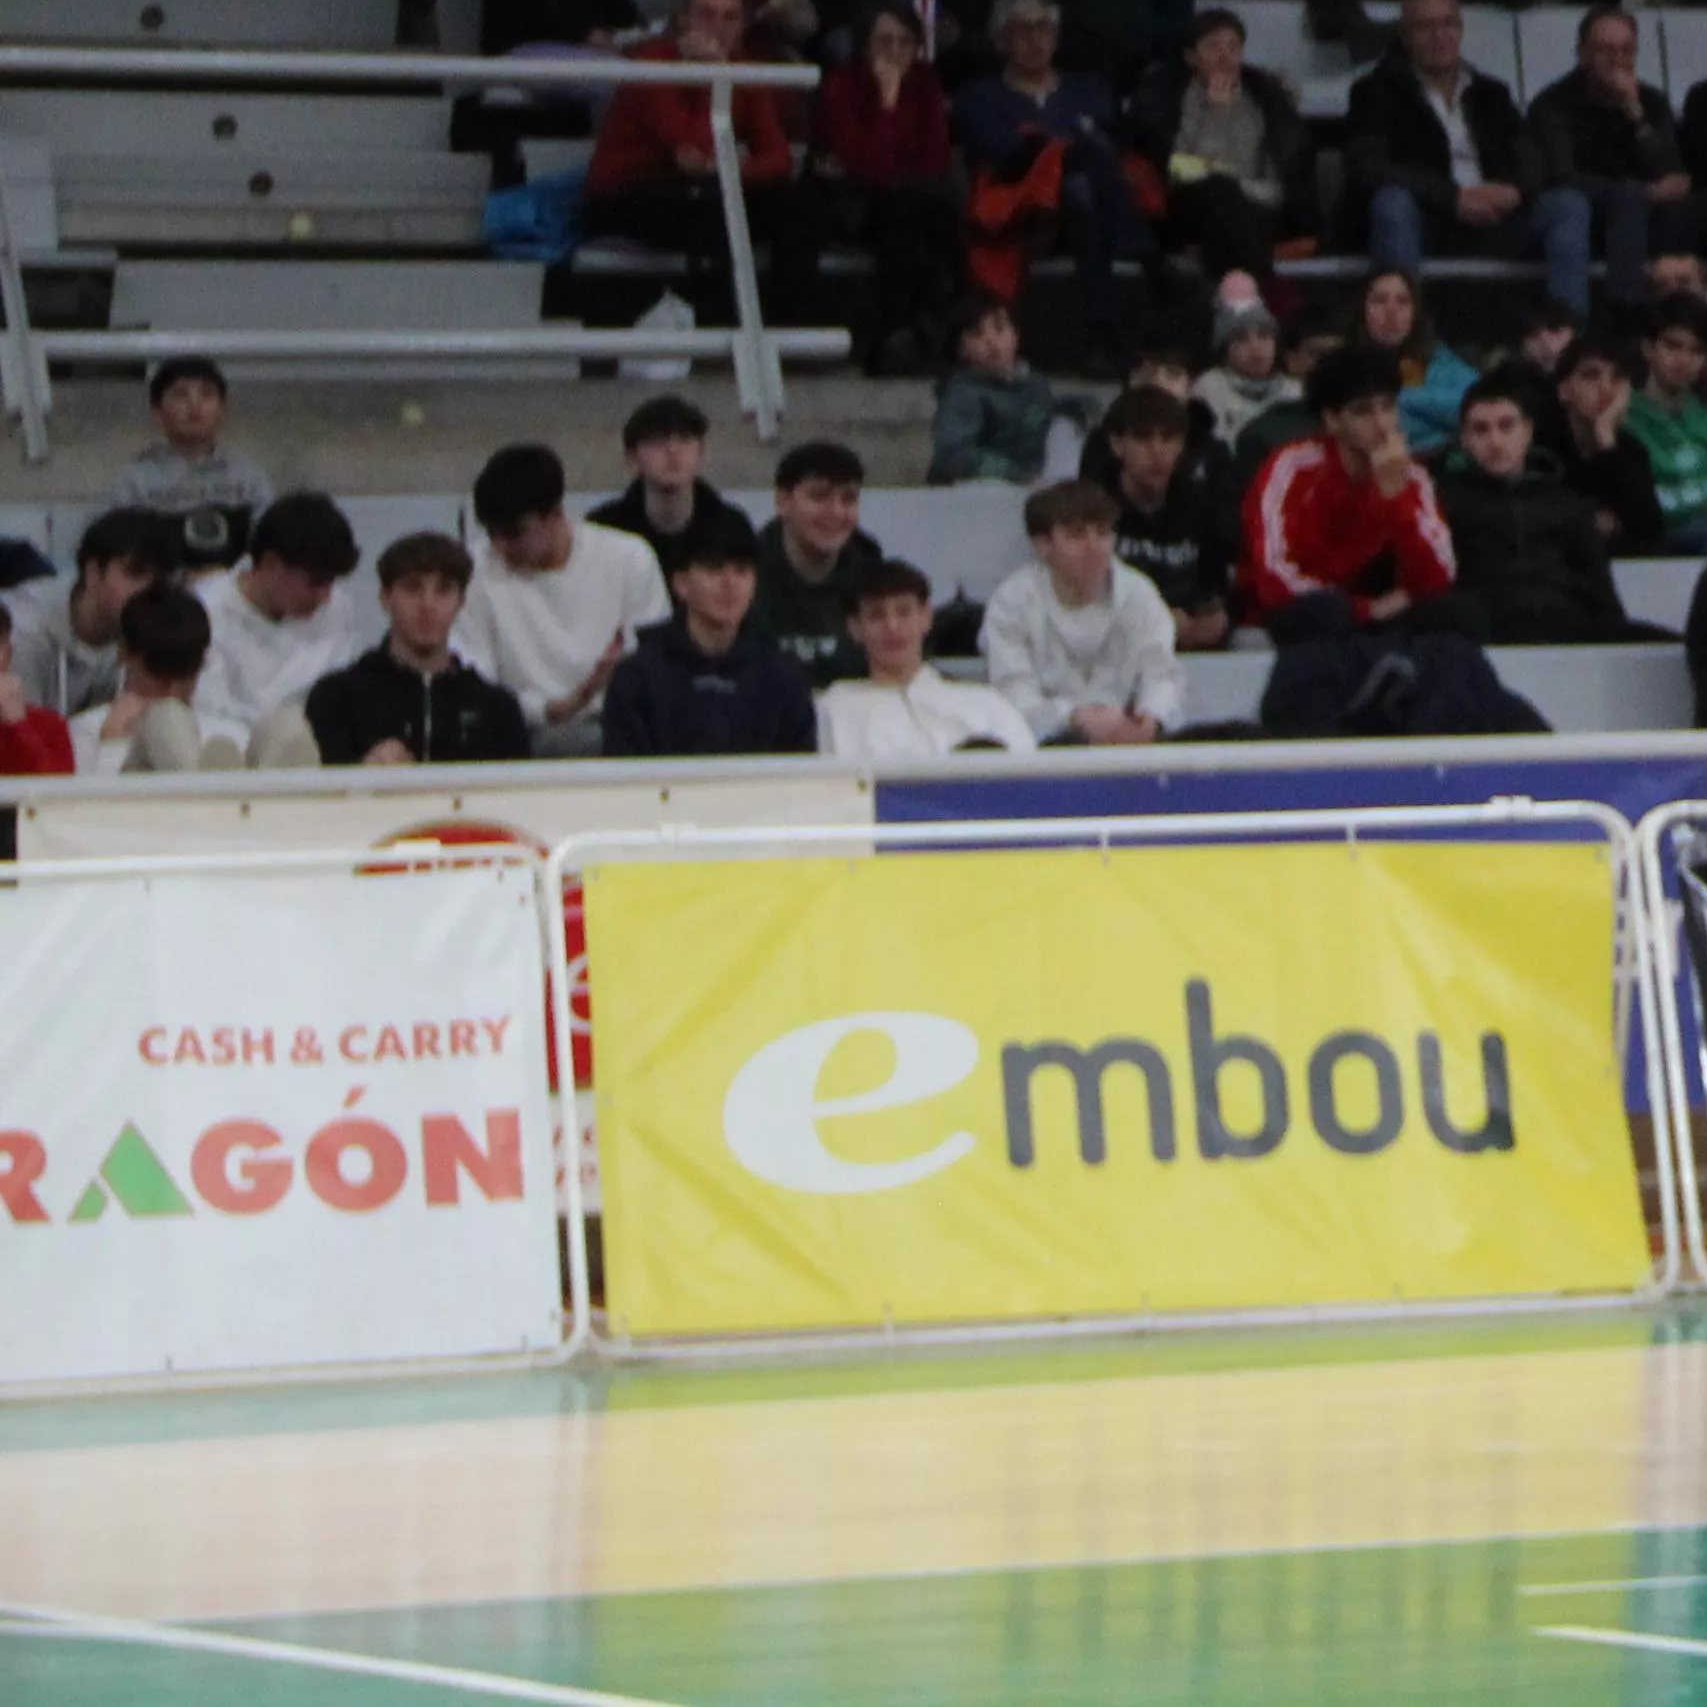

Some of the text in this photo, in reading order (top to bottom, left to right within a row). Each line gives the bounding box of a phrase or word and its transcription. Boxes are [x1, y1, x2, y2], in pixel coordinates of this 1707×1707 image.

[137, 1016, 514, 1067] CASH & CARRY
[722, 976, 1516, 1194] embou
[0, 1087, 525, 1225] RAGÓN
